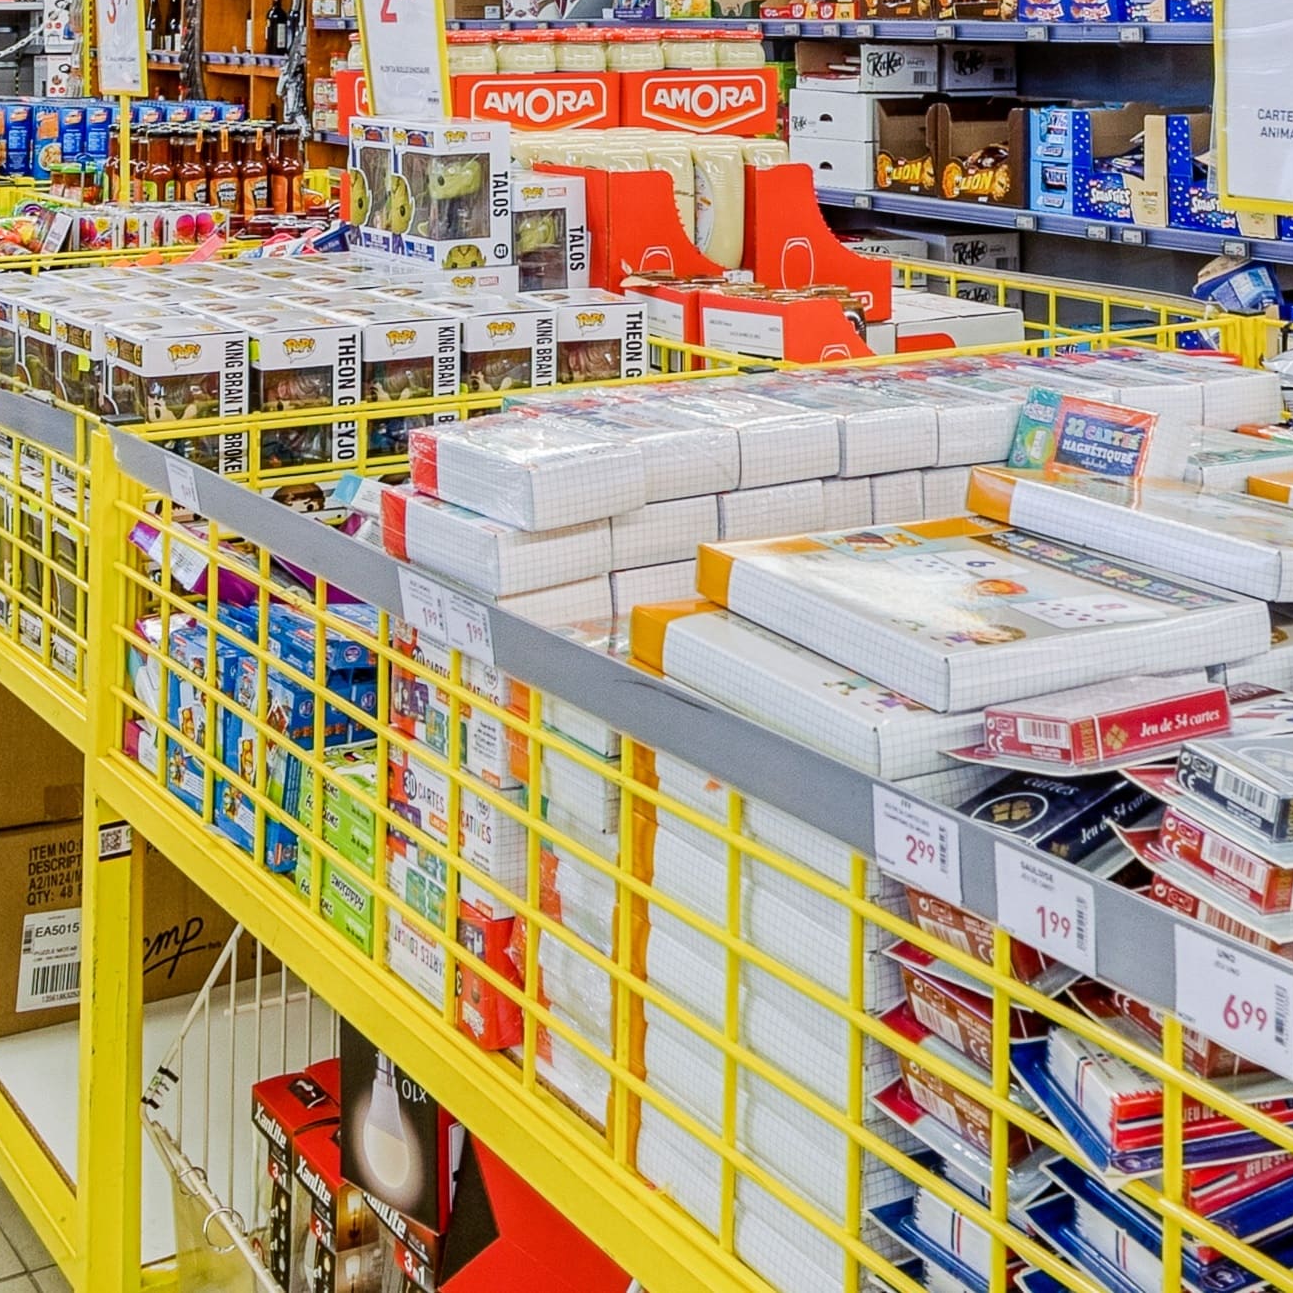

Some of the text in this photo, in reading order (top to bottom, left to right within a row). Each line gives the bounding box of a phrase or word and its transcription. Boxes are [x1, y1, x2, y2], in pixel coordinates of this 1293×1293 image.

[484, 88, 595, 124] AMORA
[653, 83, 755, 120] AMORA
[492, 171, 509, 217] TALOS
[569, 225, 585, 271] TALOS
[438, 326, 454, 388] KING BRAN
[536, 318, 553, 379] KING BRAN
[626, 311, 643, 364] THEON
[225, 339, 244, 405] KING BRAN
[338, 334, 356, 390] THEON
[224, 434, 243, 473] BROKE
[1139, 707, 1221, 738] Jeu de 54 cartes
[29, 843, 56, 861] ITEM
[27, 885, 74, 906] QTY: 48
[35, 921, 80, 938] EA5015
